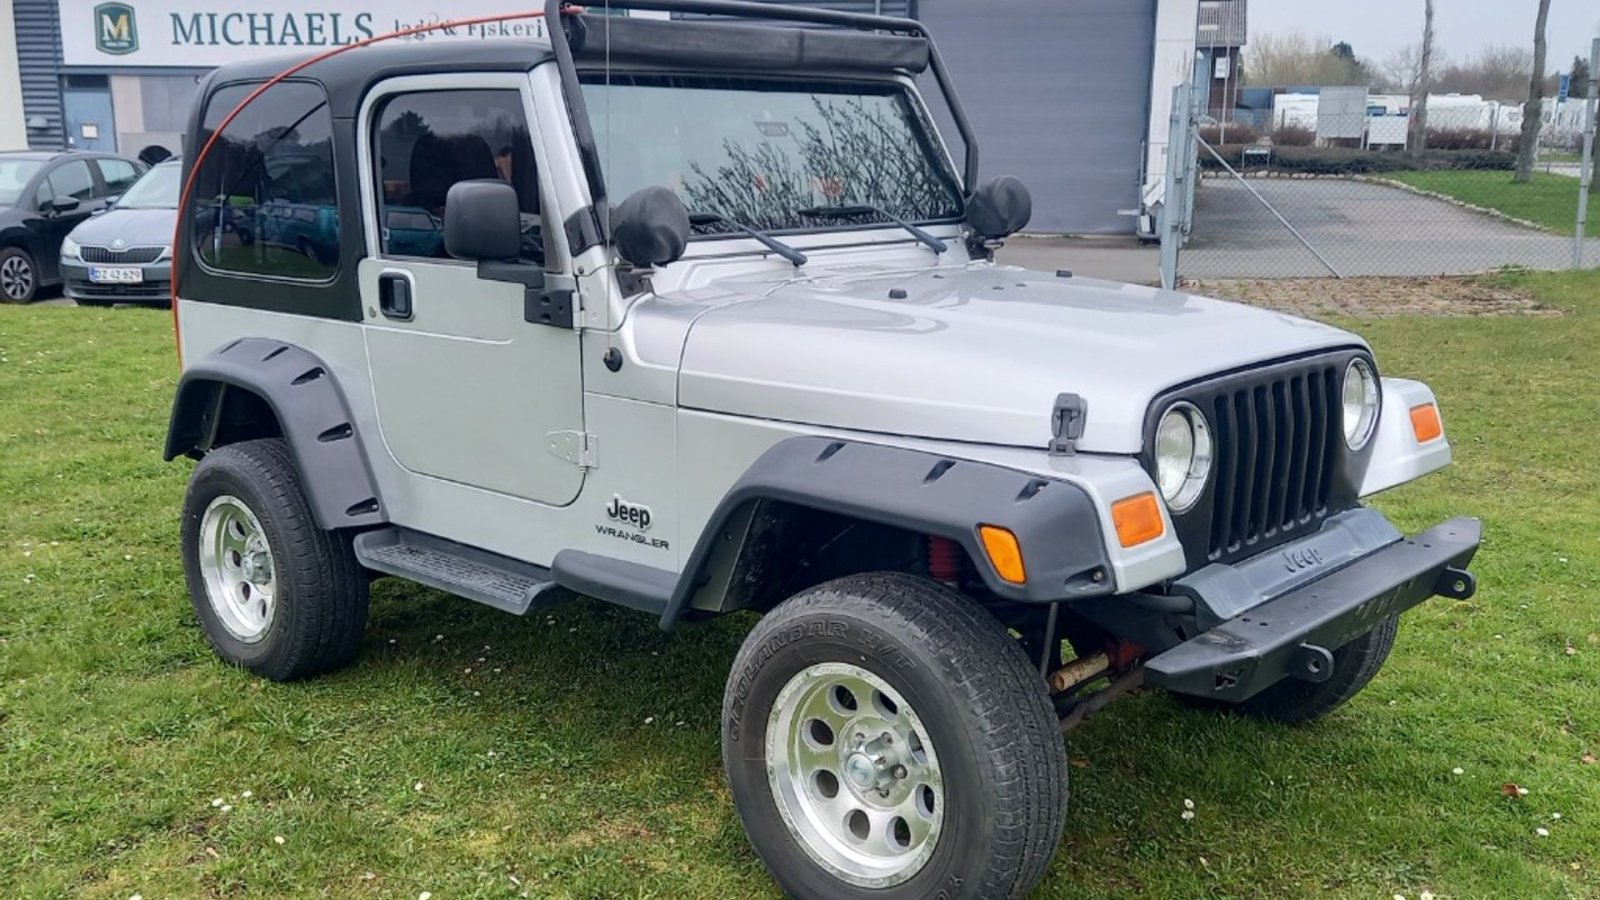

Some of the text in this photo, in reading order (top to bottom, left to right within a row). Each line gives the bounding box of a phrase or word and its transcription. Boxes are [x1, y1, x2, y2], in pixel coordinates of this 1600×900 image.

[101, 13, 131, 41] M
[169, 12, 374, 47] MICHAELS
[606, 496, 652, 531] Jeep
[595, 525, 670, 551] WRANGLER
[1282, 547, 1323, 573] Jeep
